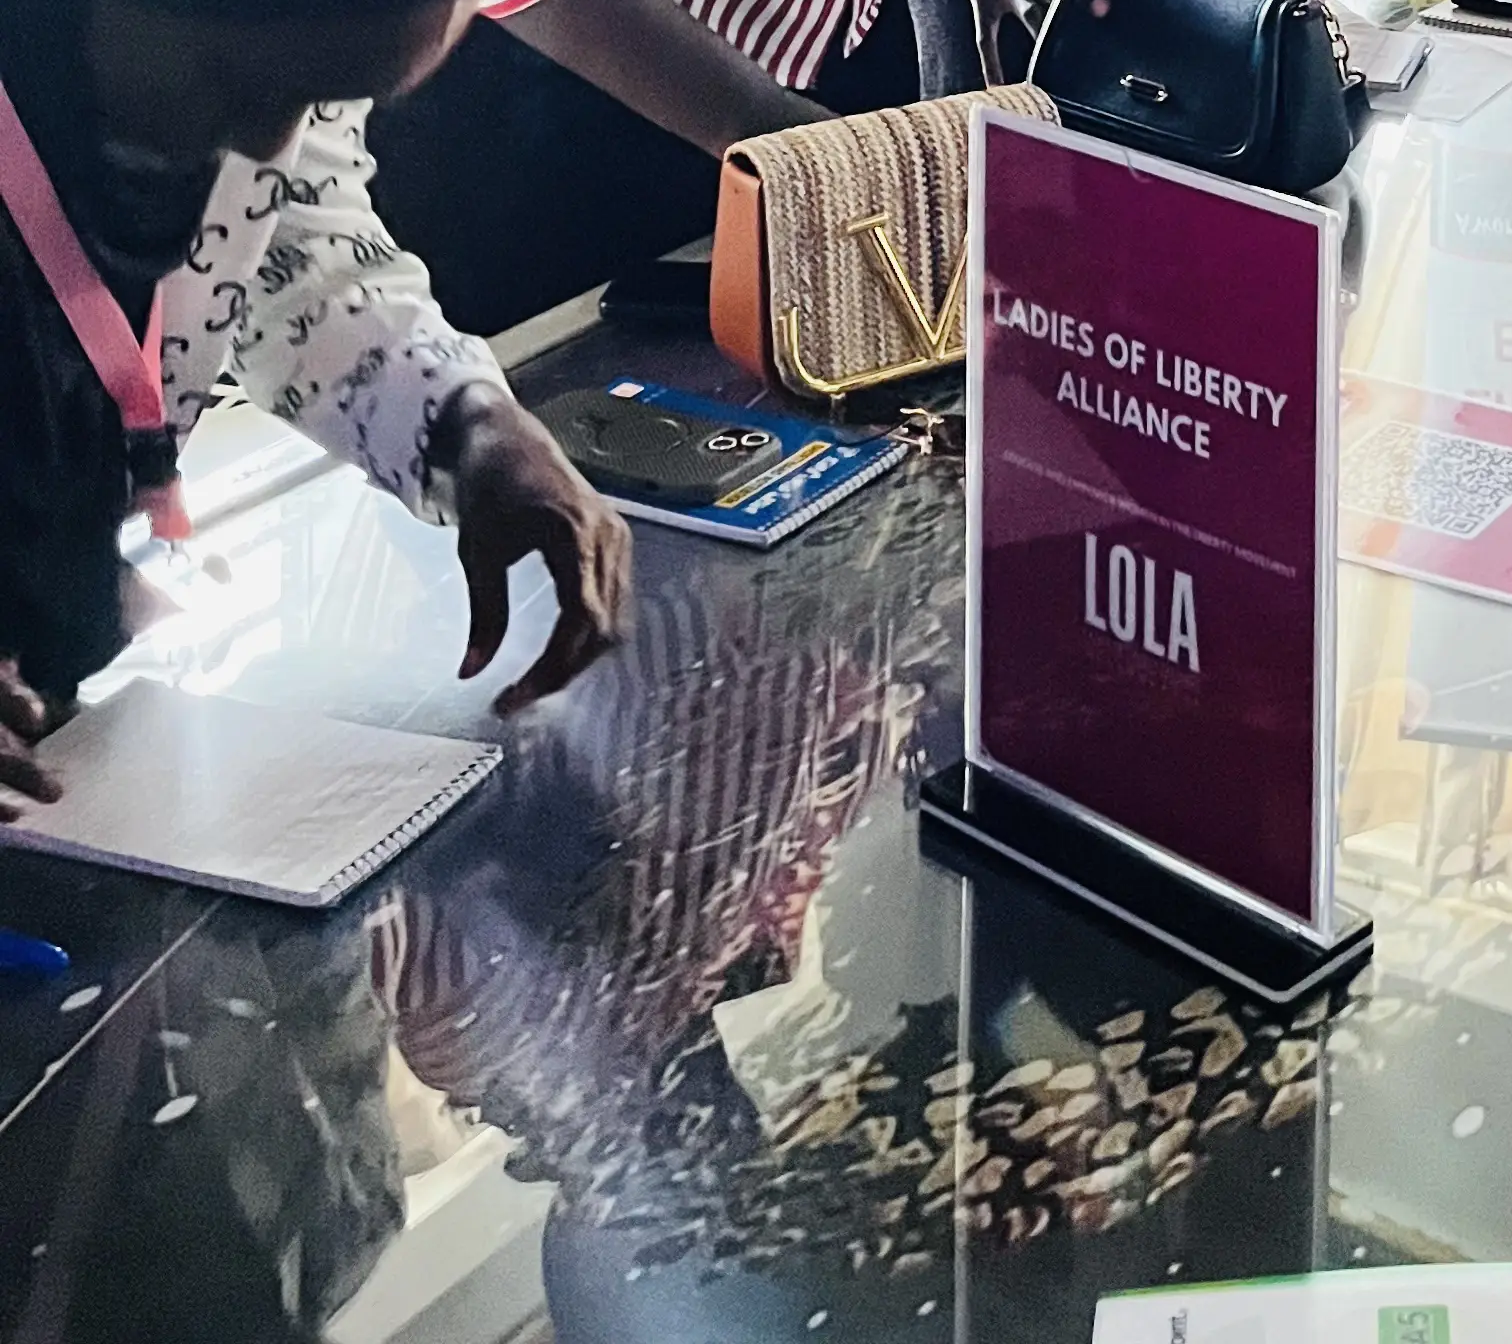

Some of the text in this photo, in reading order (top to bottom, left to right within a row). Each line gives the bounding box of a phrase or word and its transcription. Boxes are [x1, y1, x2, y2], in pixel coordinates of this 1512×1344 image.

[993, 288, 1288, 428] LADIES OF LIBERTY
[1057, 371, 1210, 459] ALLIANCE
[1085, 530, 1200, 673] LOLA
